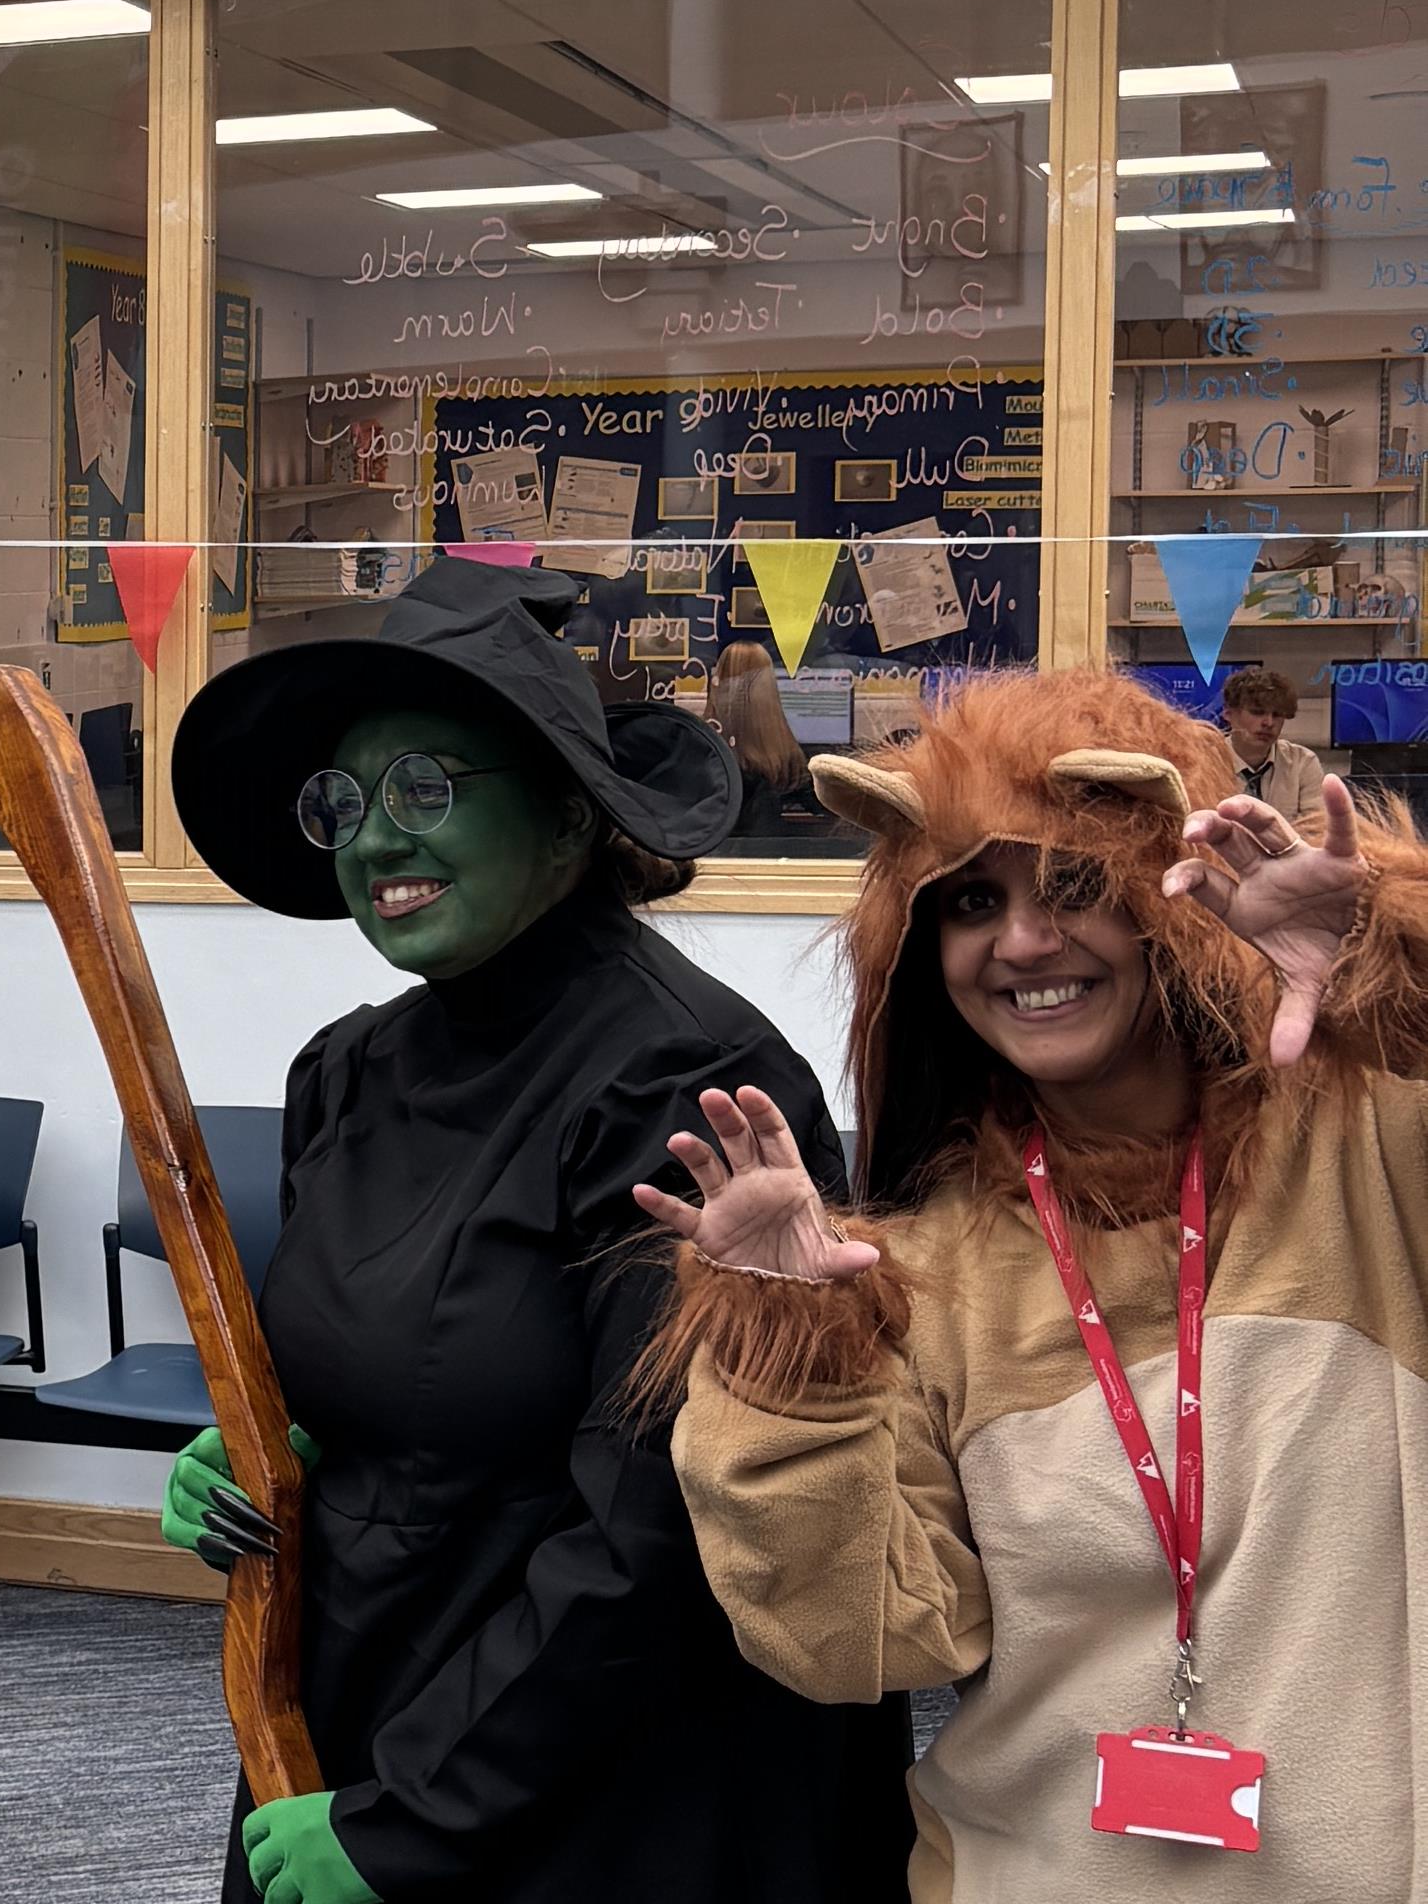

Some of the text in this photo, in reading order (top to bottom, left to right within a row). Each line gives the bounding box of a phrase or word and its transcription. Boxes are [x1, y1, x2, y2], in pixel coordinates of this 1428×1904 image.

[110, 283, 137, 324] Year
[581, 402, 663, 436] Year
[748, 406, 878, 432] Jewellery
[945, 492, 991, 507] Laser
